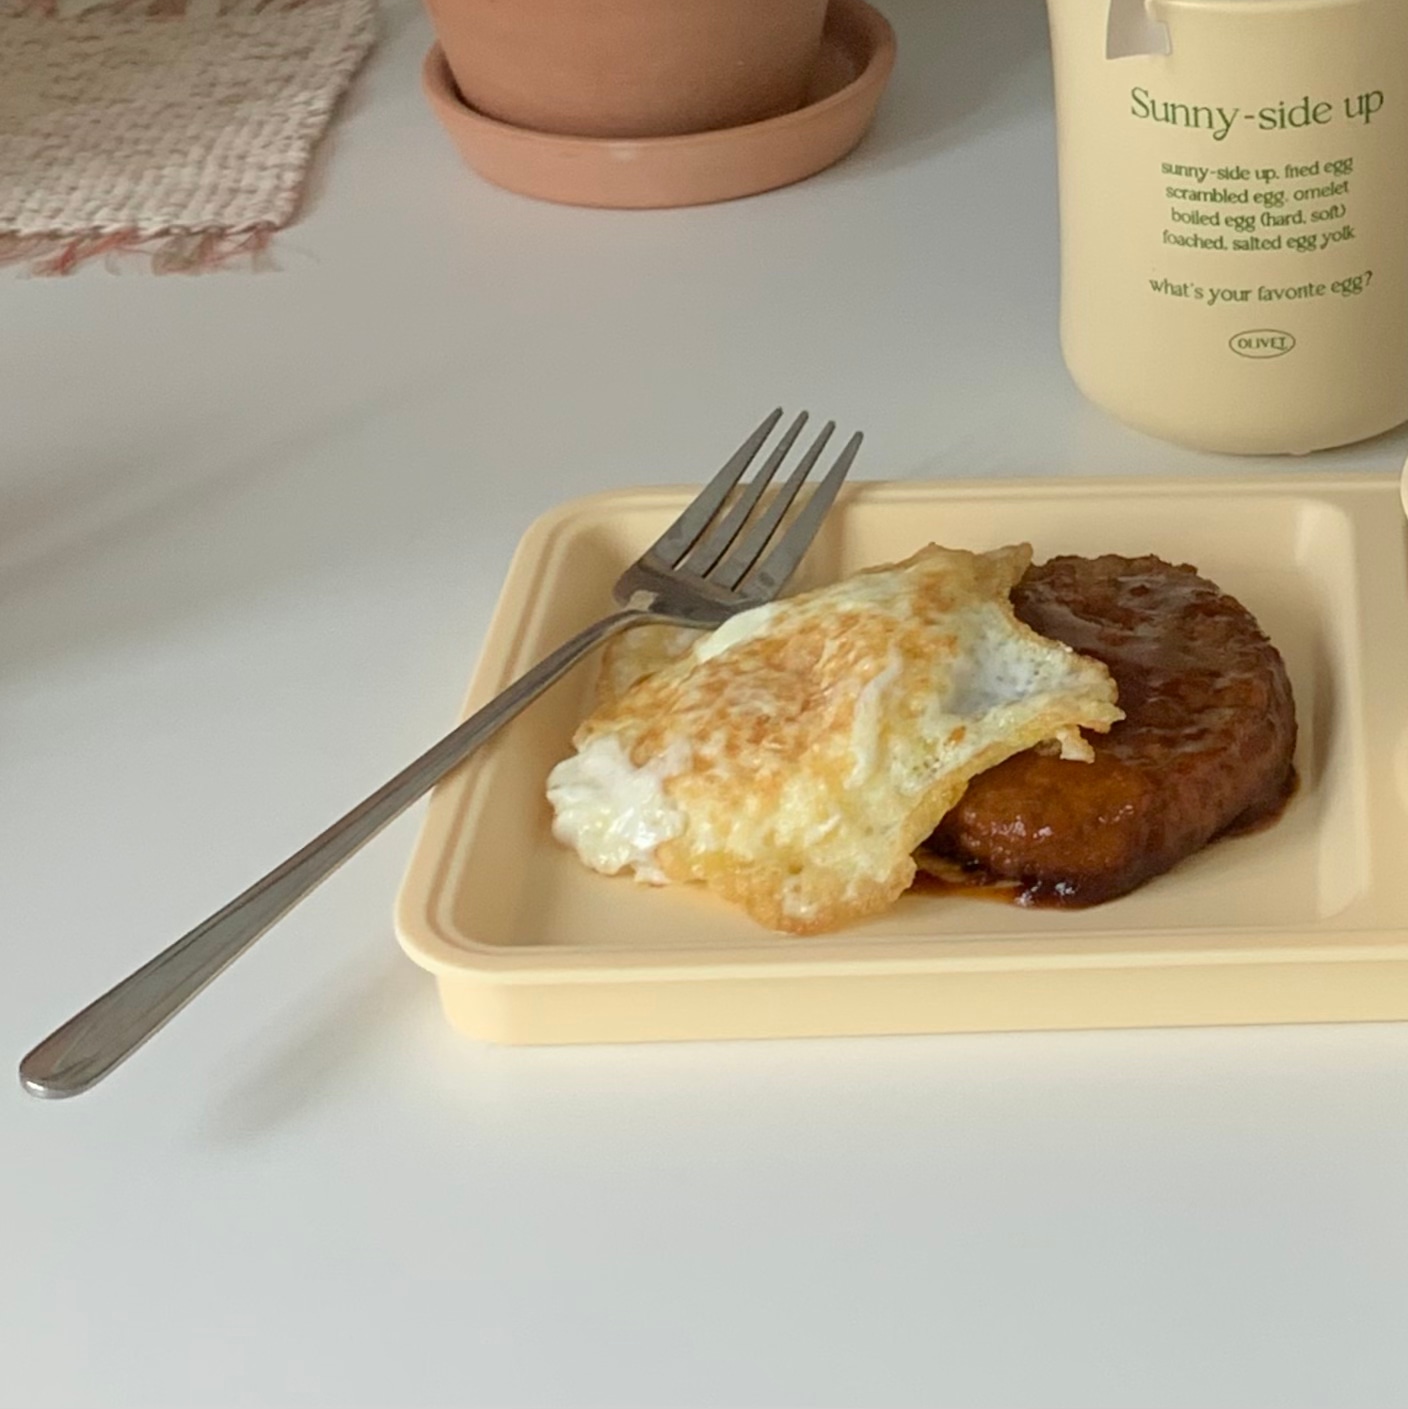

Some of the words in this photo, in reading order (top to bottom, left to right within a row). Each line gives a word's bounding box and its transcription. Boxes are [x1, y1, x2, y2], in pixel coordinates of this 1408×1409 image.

[1130, 86, 1333, 141] Sunny-side
[1343, 89, 1385, 125] up
[1160, 161, 1250, 183] sunny-side
[1284, 160, 1320, 179] fried
[1323, 157, 1354, 176] egg
[1165, 186, 1249, 204] scrambled
[1293, 180, 1350, 201] omelet
[1171, 207, 1220, 226] boiled
[1224, 214, 1256, 232] egg
[1310, 204, 1347, 222] soft)
[1232, 235, 1282, 251] salted
[1286, 233, 1317, 252] egg
[1320, 225, 1356, 250] yolk
[1148, 278, 1204, 300] what's
[1206, 287, 1252, 306] your
[1257, 282, 1327, 302] favorite
[1330, 269, 1374, 298] egg?
